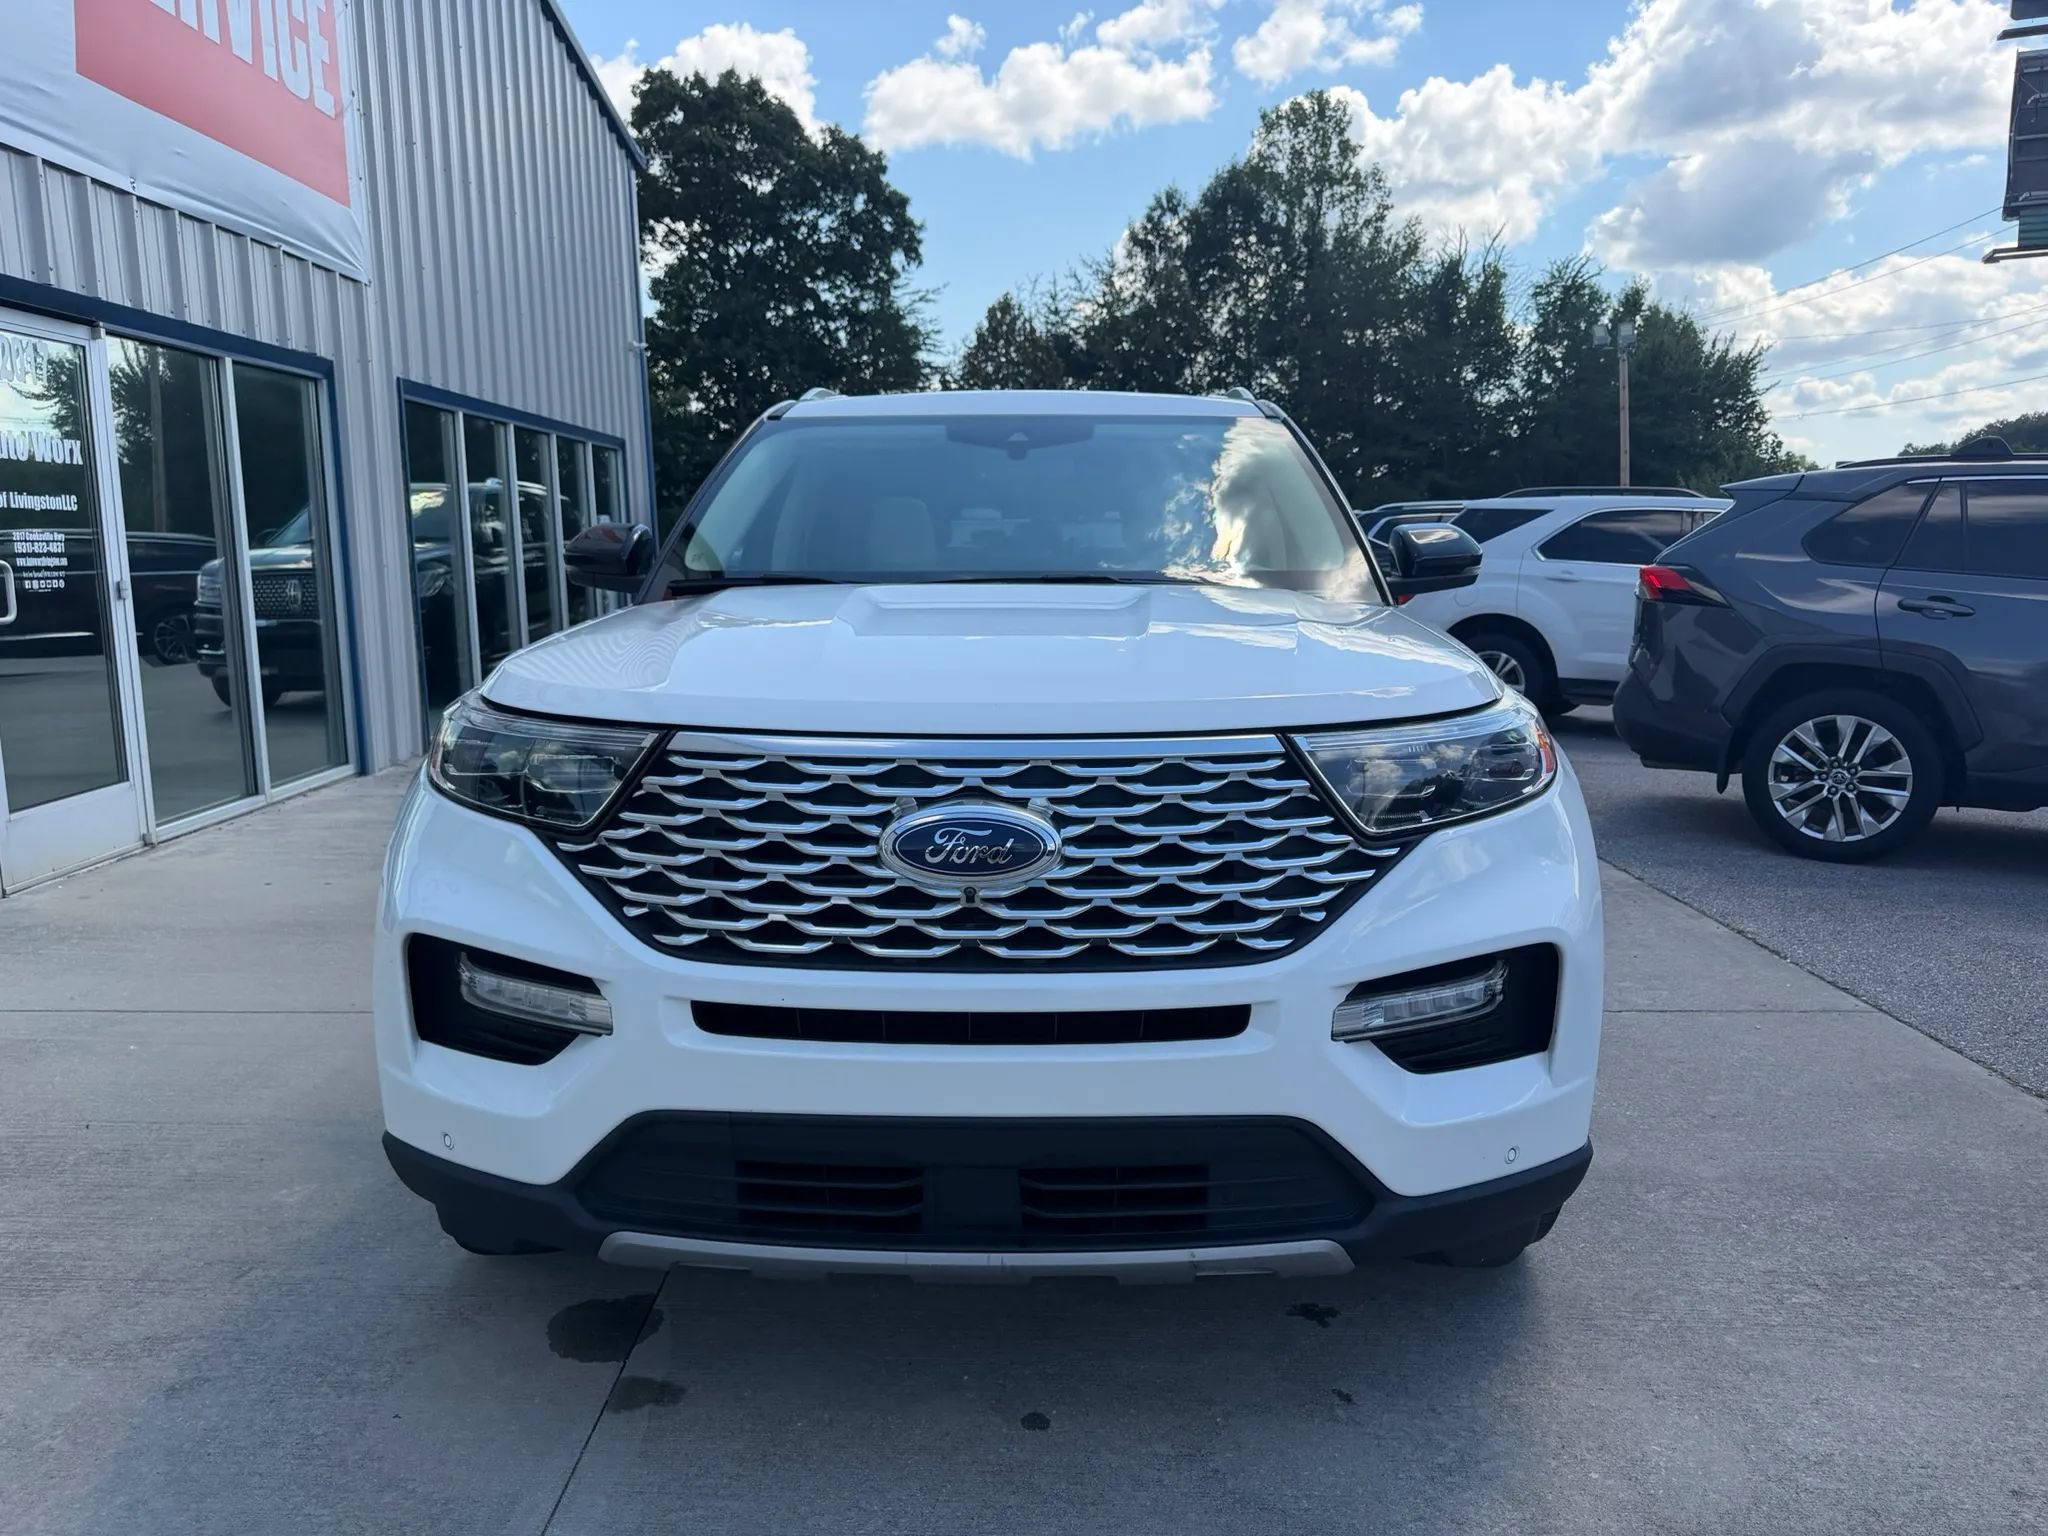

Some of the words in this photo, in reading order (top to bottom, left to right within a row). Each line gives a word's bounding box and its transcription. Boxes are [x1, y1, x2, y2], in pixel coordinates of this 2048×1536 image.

[149, 0, 336, 119] ICE
[31, 432, 84, 465] Worx
[925, 827, 1015, 865] Ford
